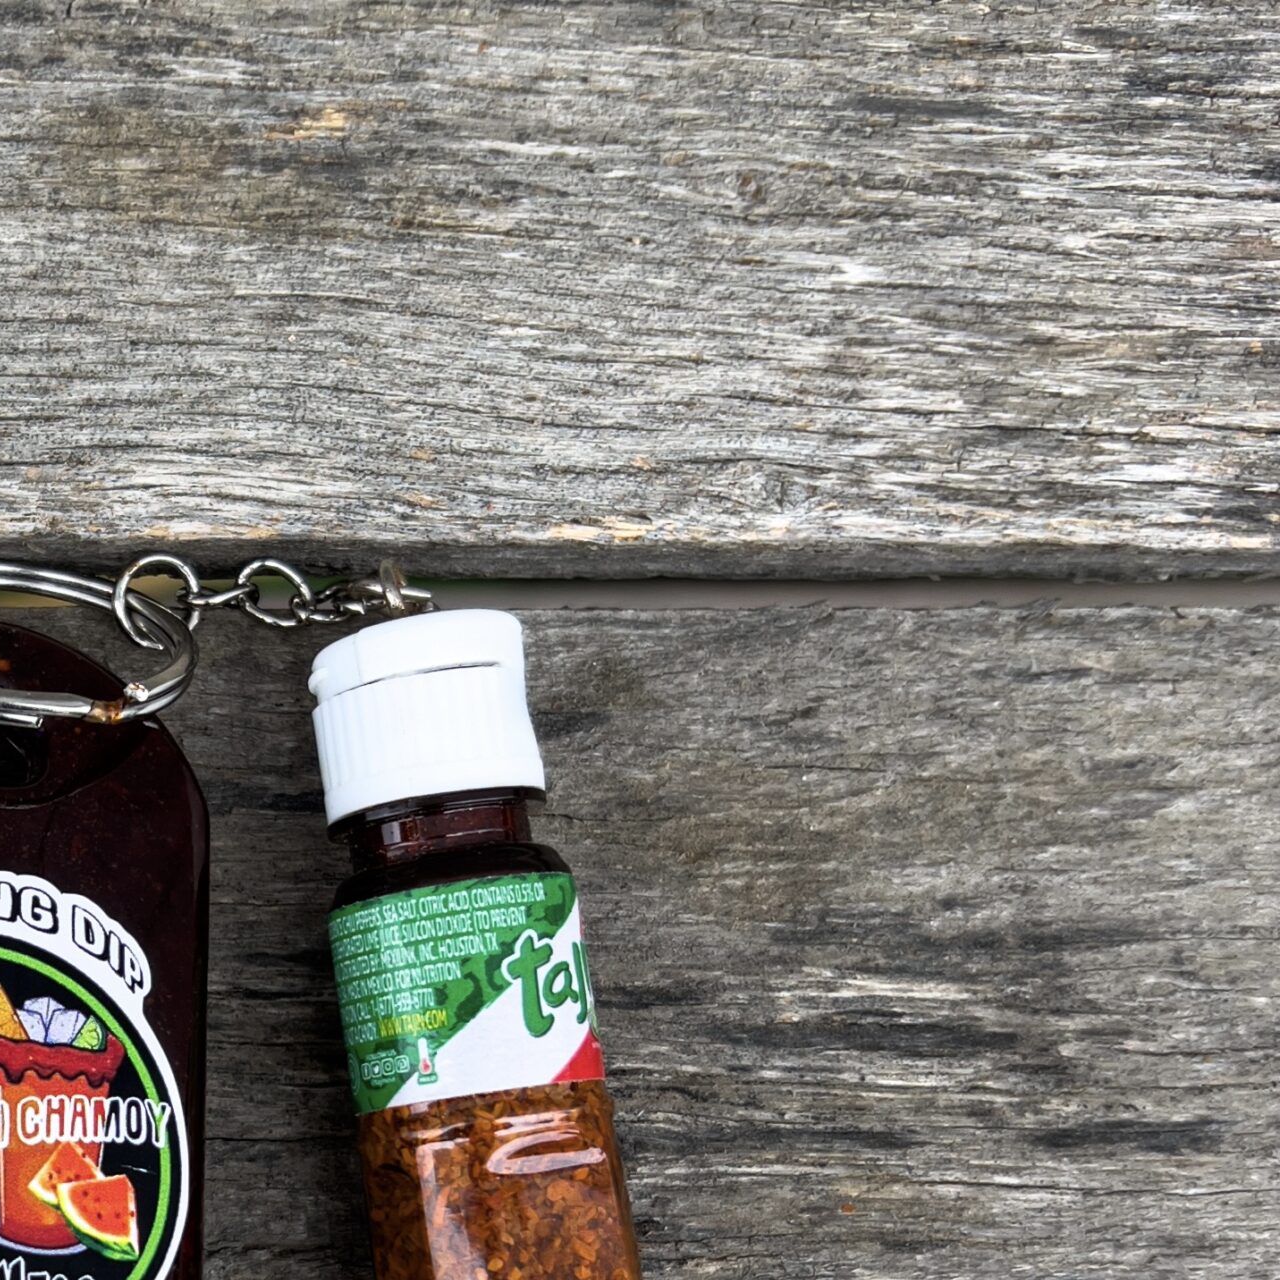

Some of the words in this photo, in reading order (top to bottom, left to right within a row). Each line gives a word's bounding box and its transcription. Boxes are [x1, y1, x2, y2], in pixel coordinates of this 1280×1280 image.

[471, 884, 516, 908] CONTAINS
[490, 905, 527, 928] PREVENT
[70, 905, 144, 992] DIP
[20, 1094, 170, 1149] CHAMOY
